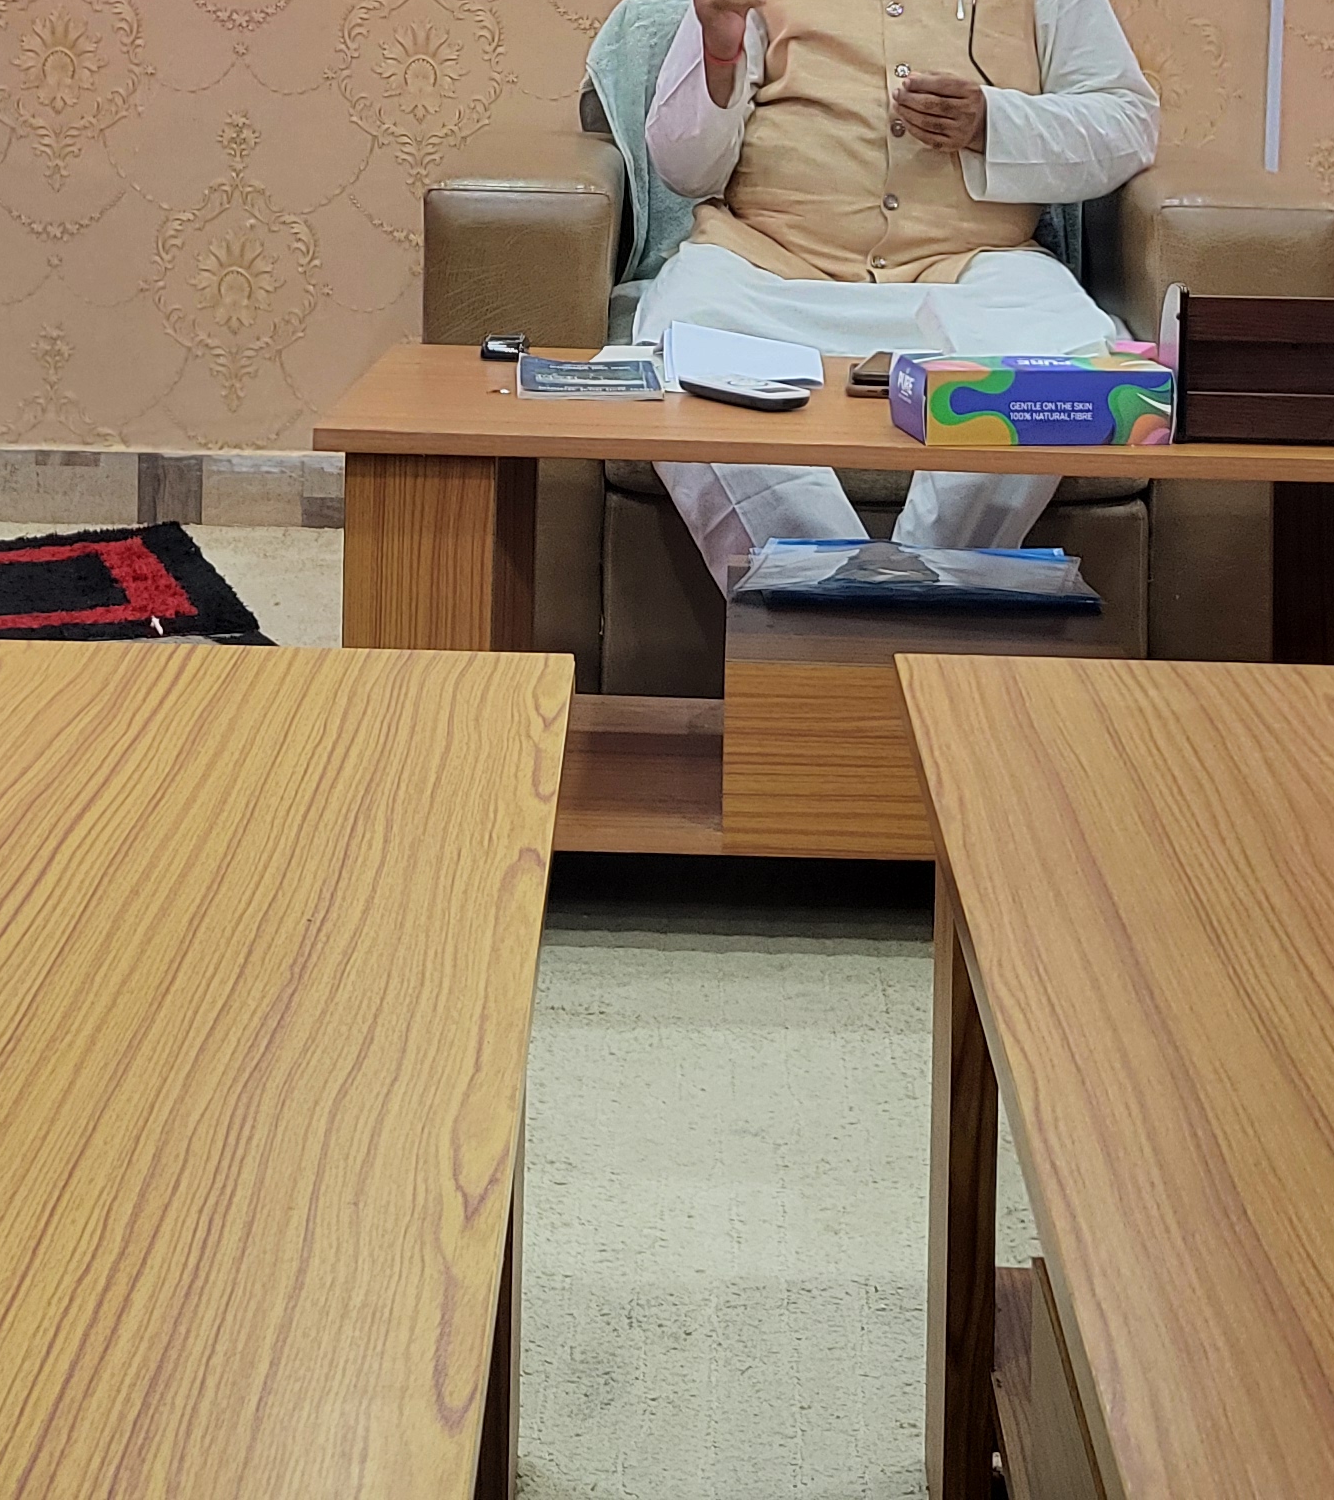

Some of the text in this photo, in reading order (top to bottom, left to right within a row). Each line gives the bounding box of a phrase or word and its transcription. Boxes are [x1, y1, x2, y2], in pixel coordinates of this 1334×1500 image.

[1010, 402, 1093, 411] GENTLE ON THE SKIN
[1010, 412, 1093, 421] 100% NATURAL FIBRE
